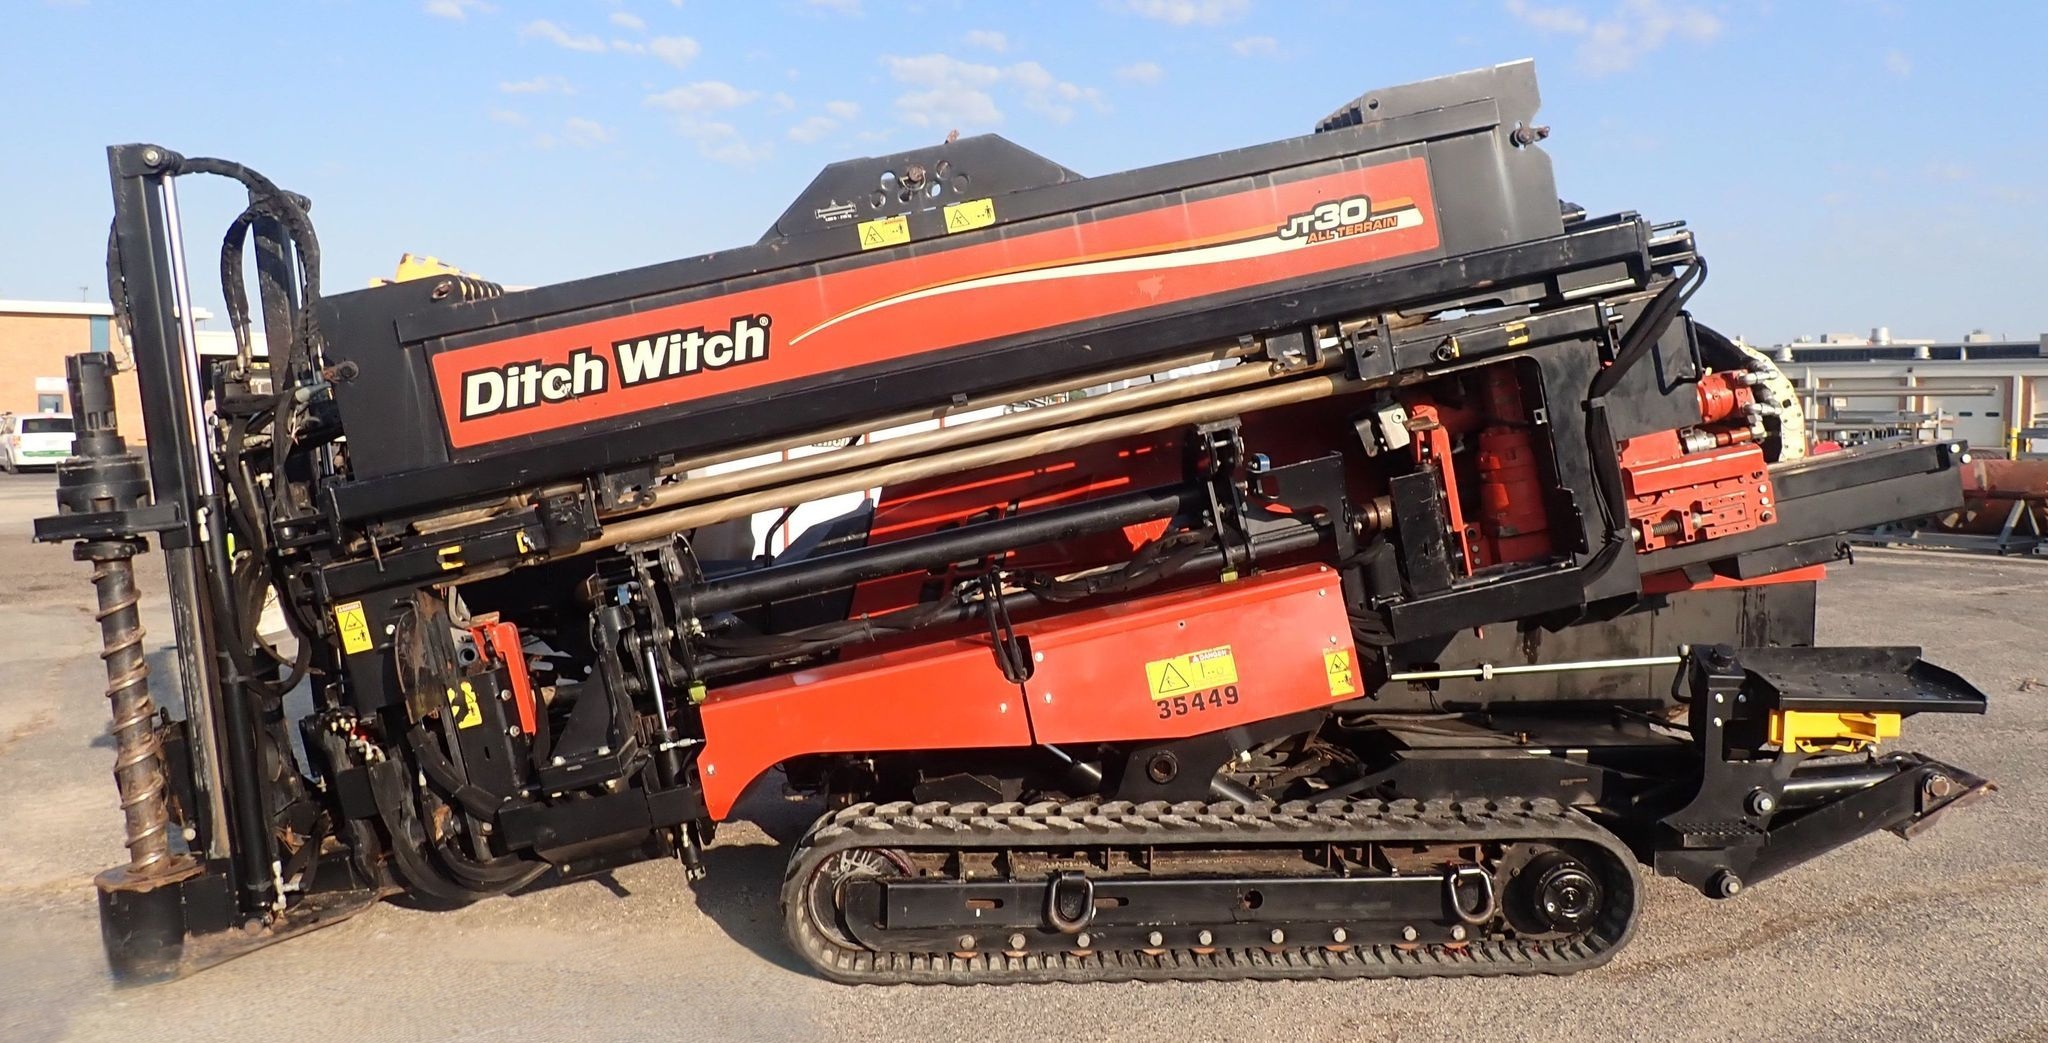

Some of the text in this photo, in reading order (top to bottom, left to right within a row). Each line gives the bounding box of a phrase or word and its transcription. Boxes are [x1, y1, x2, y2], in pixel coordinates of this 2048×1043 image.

[1281, 197, 1369, 239] JT30
[1307, 216, 1398, 244] ALL TERRAIN
[464, 351, 605, 417] Ditch
[1156, 685, 1239, 719] 35449
